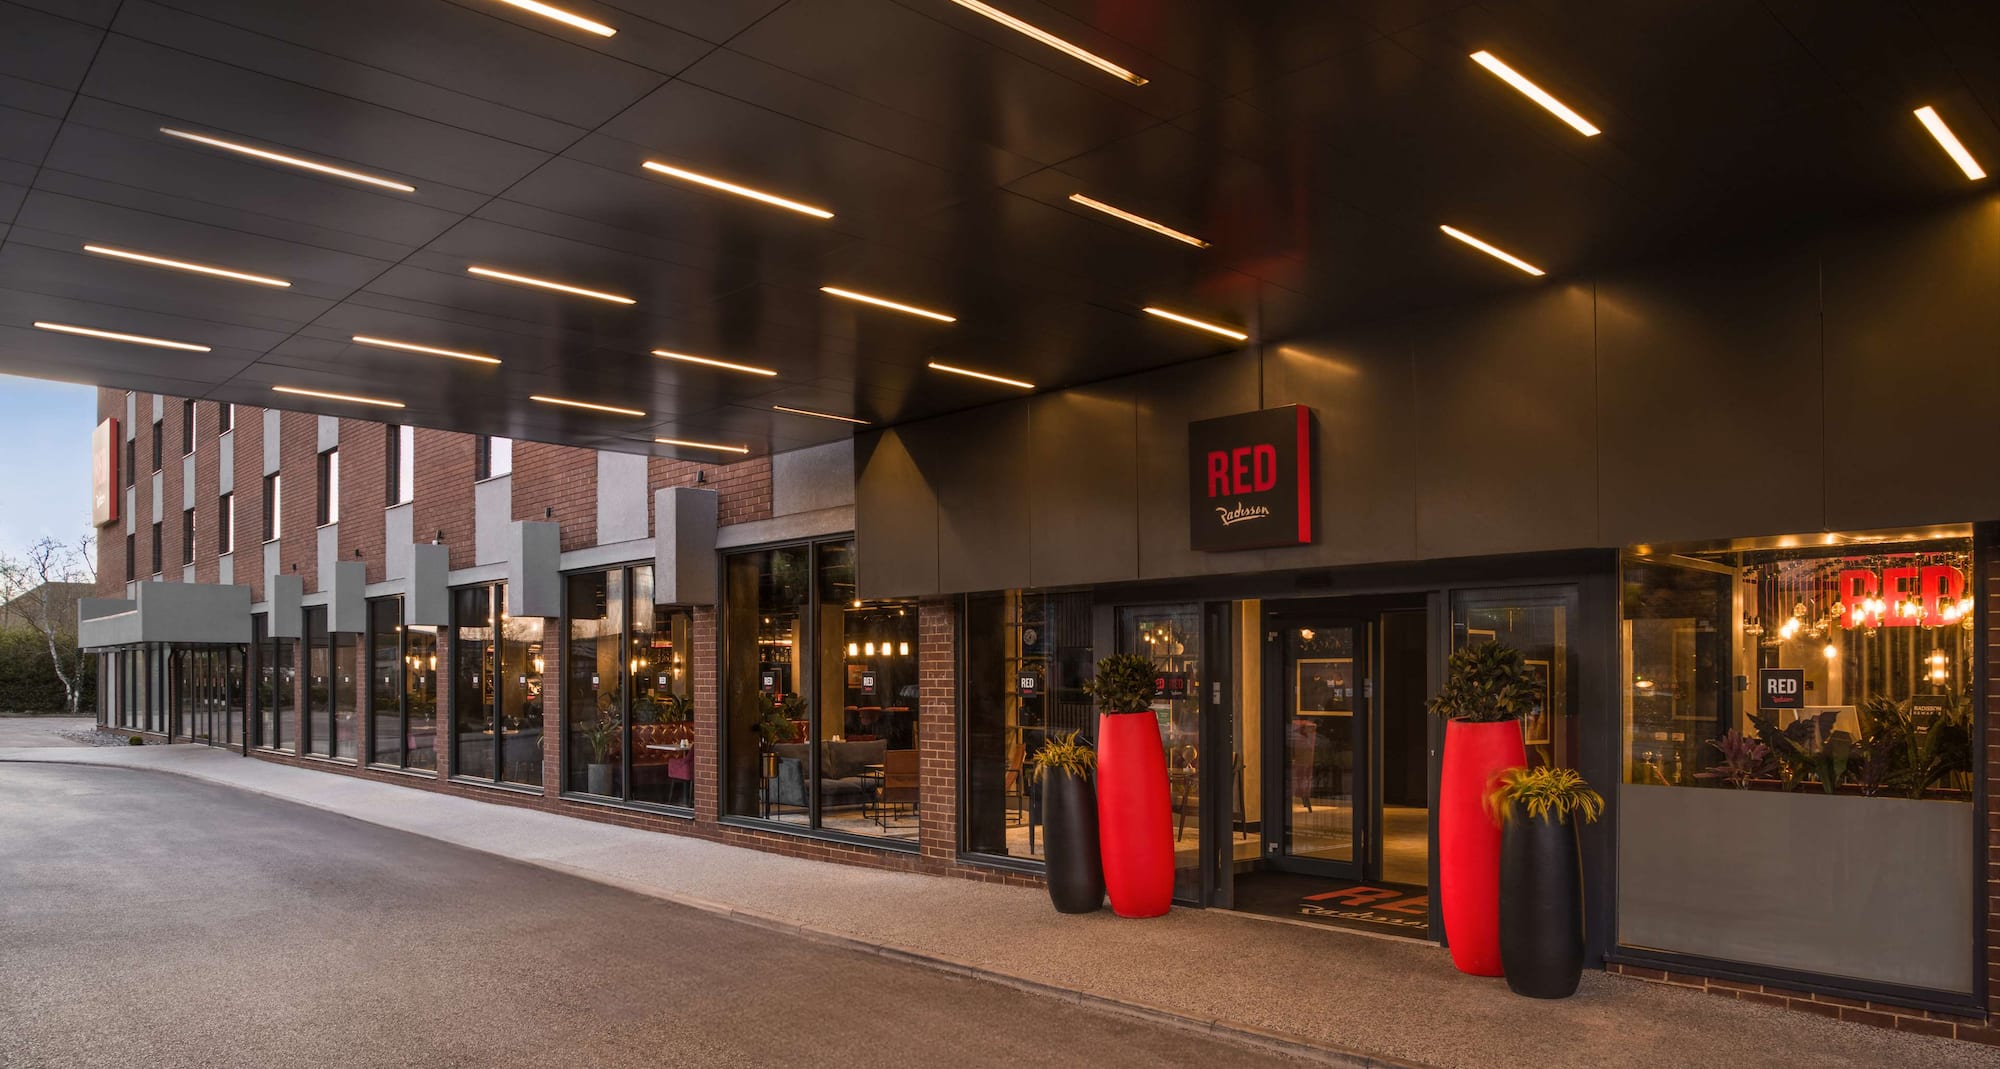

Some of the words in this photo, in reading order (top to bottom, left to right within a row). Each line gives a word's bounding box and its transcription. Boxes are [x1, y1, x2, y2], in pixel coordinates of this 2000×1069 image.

[1207, 443, 1277, 498] RED
[1215, 501, 1270, 526] Radisson
[1839, 565, 1965, 629] RED
[1021, 677, 1034, 689] RED
[1767, 678, 1797, 694] RED
